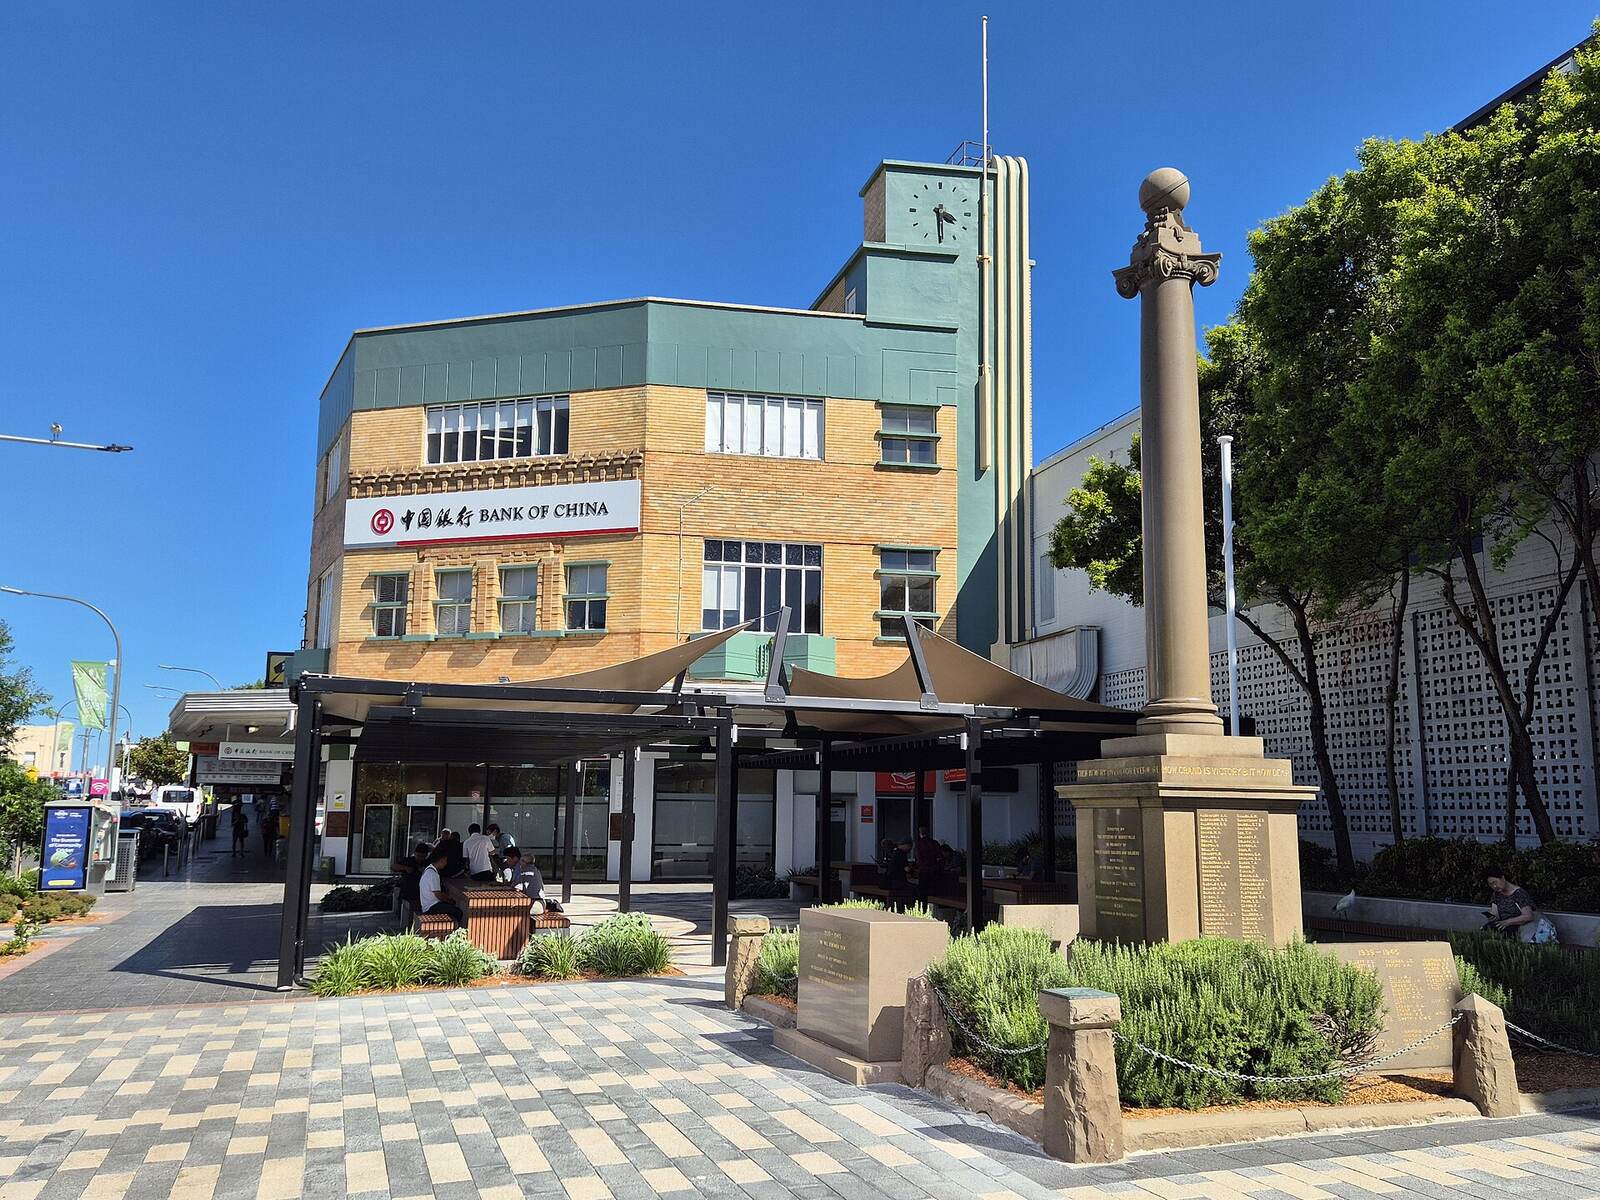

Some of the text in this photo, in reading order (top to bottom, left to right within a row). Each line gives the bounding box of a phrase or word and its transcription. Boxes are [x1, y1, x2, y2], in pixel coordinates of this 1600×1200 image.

[400, 506, 474, 531] 中国银行
[479, 501, 609, 522] BANK OF CHINA
